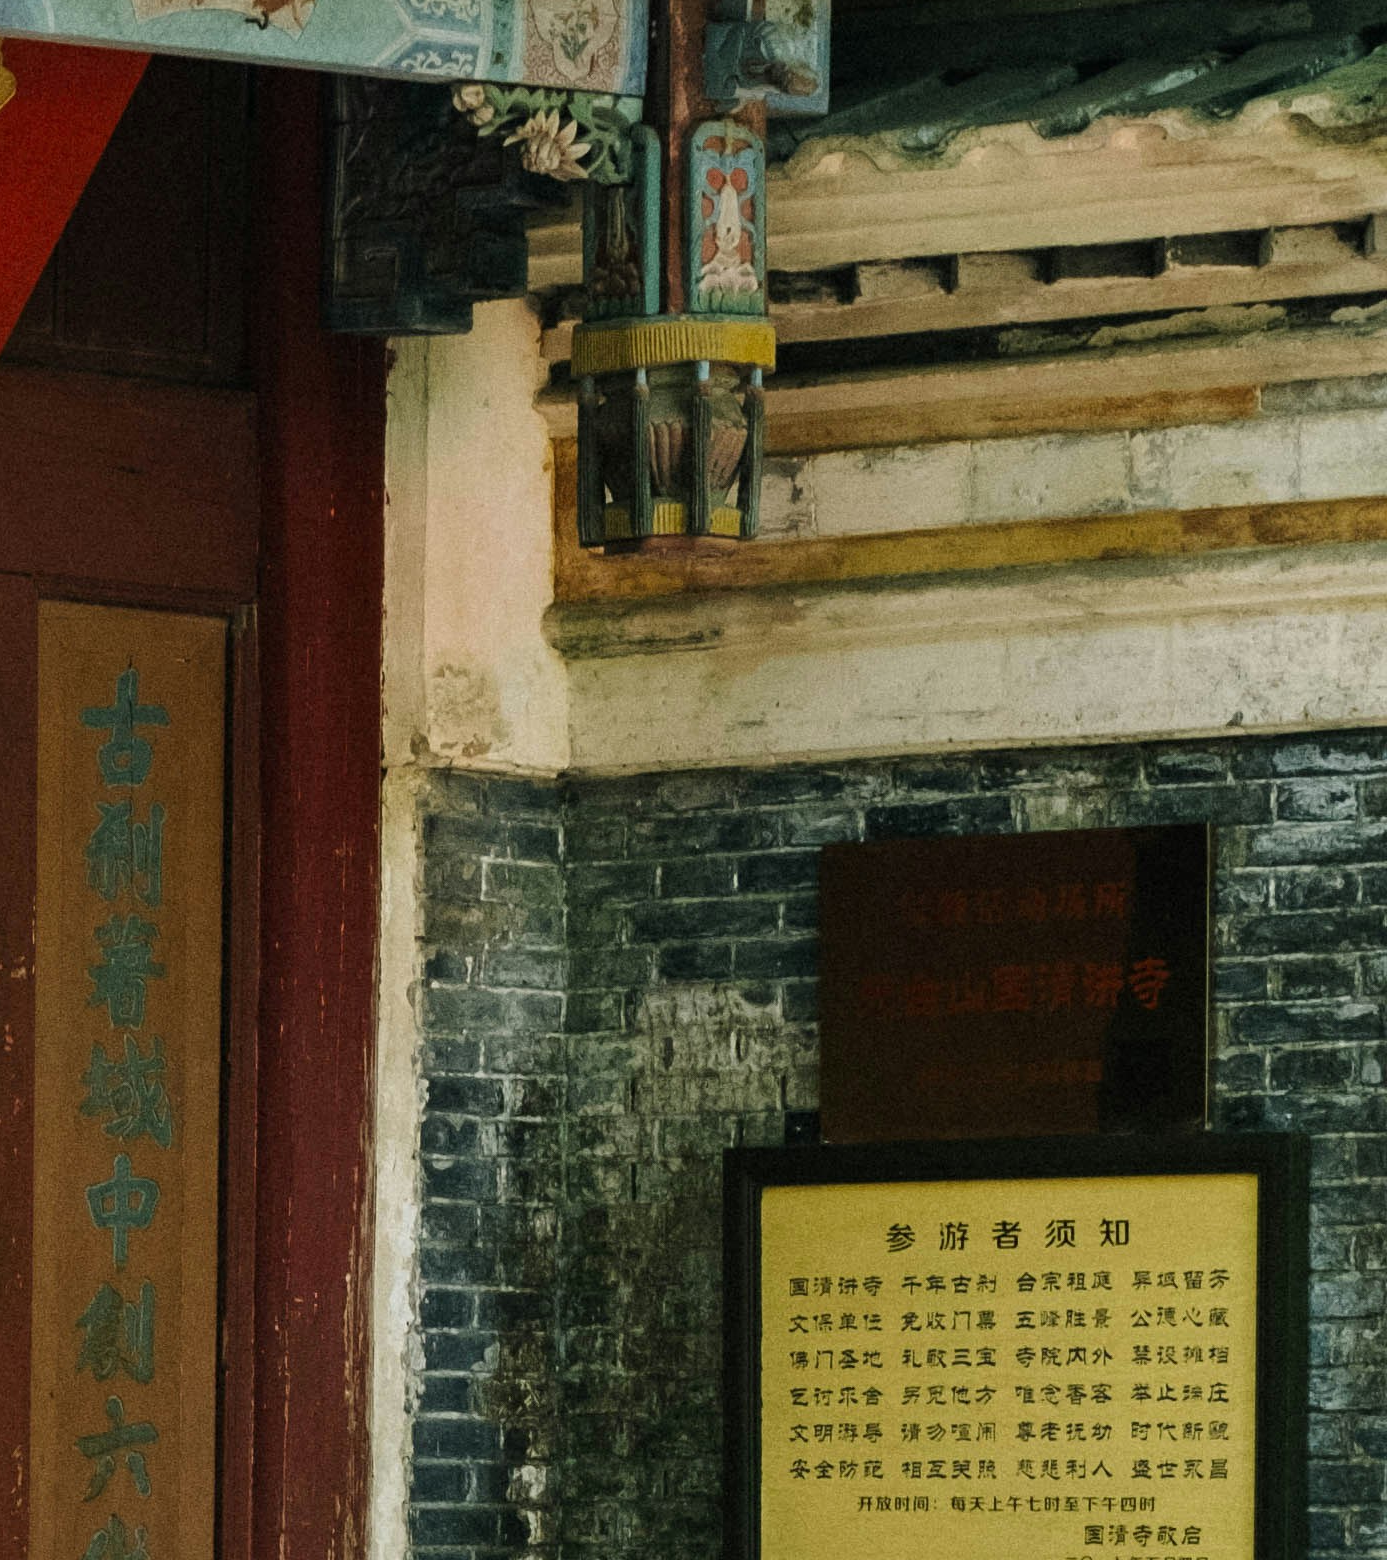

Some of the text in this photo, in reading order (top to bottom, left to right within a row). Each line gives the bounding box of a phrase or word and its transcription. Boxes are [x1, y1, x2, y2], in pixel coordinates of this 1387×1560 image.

[886, 1218, 1130, 1253] 参游者须知
[789, 1275, 883, 1297] 国清讲寺
[901, 1274, 997, 1295] 千年古刹
[788, 1306, 1230, 1334] 文保单位 免收门票 五峰胜景 公德心藏
[789, 1344, 1229, 1370] 佛门圣地 礼敬三宝 寺院内外 禁设摊档
[901, 1385, 997, 1406] 另觅他方
[900, 1422, 996, 1442] 请勿喧闹
[1015, 1421, 1113, 1442] 尊老抚幼
[789, 1458, 1228, 1481] 安全防范 相互关照 慈悲利人 盛世永昌
[1084, 1524, 1202, 1548] 国清寺敬启
